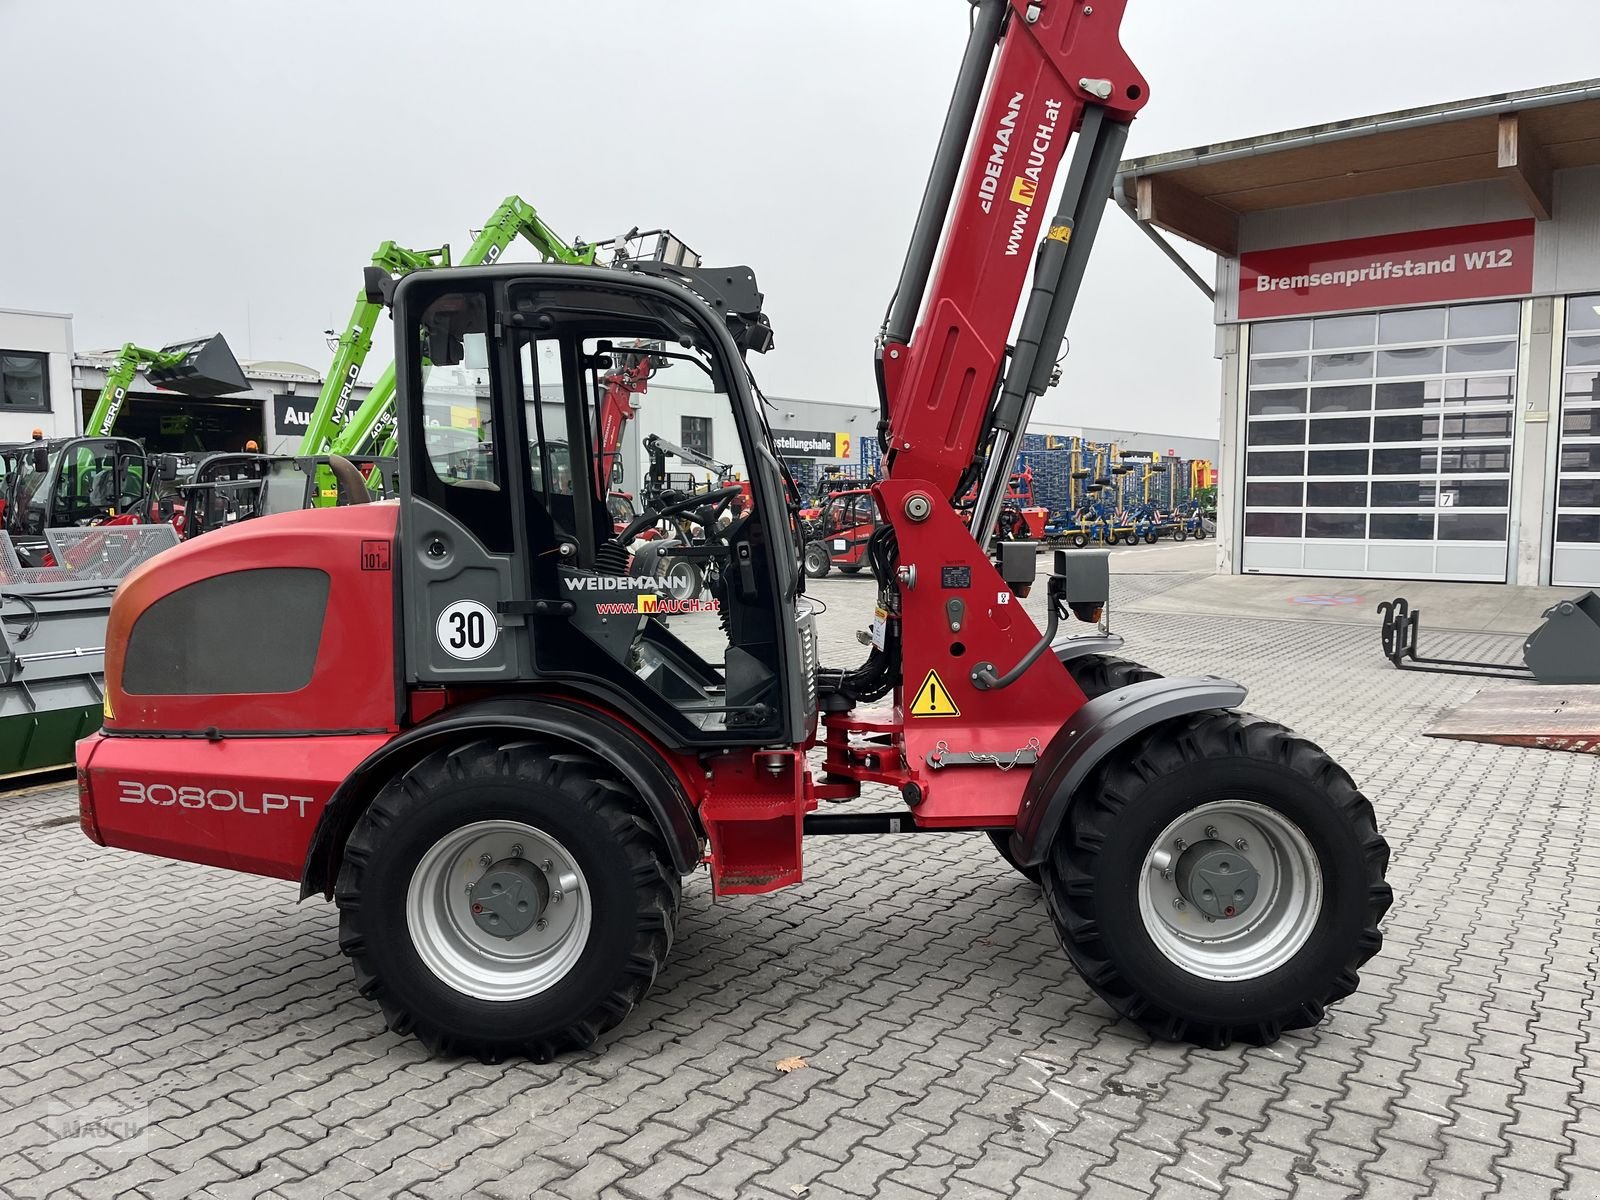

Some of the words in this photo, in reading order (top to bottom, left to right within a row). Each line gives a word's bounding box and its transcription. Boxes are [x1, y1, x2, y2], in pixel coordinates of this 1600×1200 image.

[1005, 98, 1062, 256] www.MAUCH.at
[1256, 254, 1456, 292] Bremsenprüfstand
[1463, 248, 1513, 270] W12
[331, 363, 360, 424] MERLO
[1528, 401, 1534, 410] 7
[100, 387, 125, 436] MERLO
[841, 440, 851, 459] 2
[1442, 494, 1451, 506] 7
[363, 553, 380, 569] 101
[563, 575, 687, 591] WEIDEMANN
[595, 599, 721, 615] www.MAUCH.at
[449, 611, 485, 649] 30
[118, 780, 315, 818] 3080LPT
